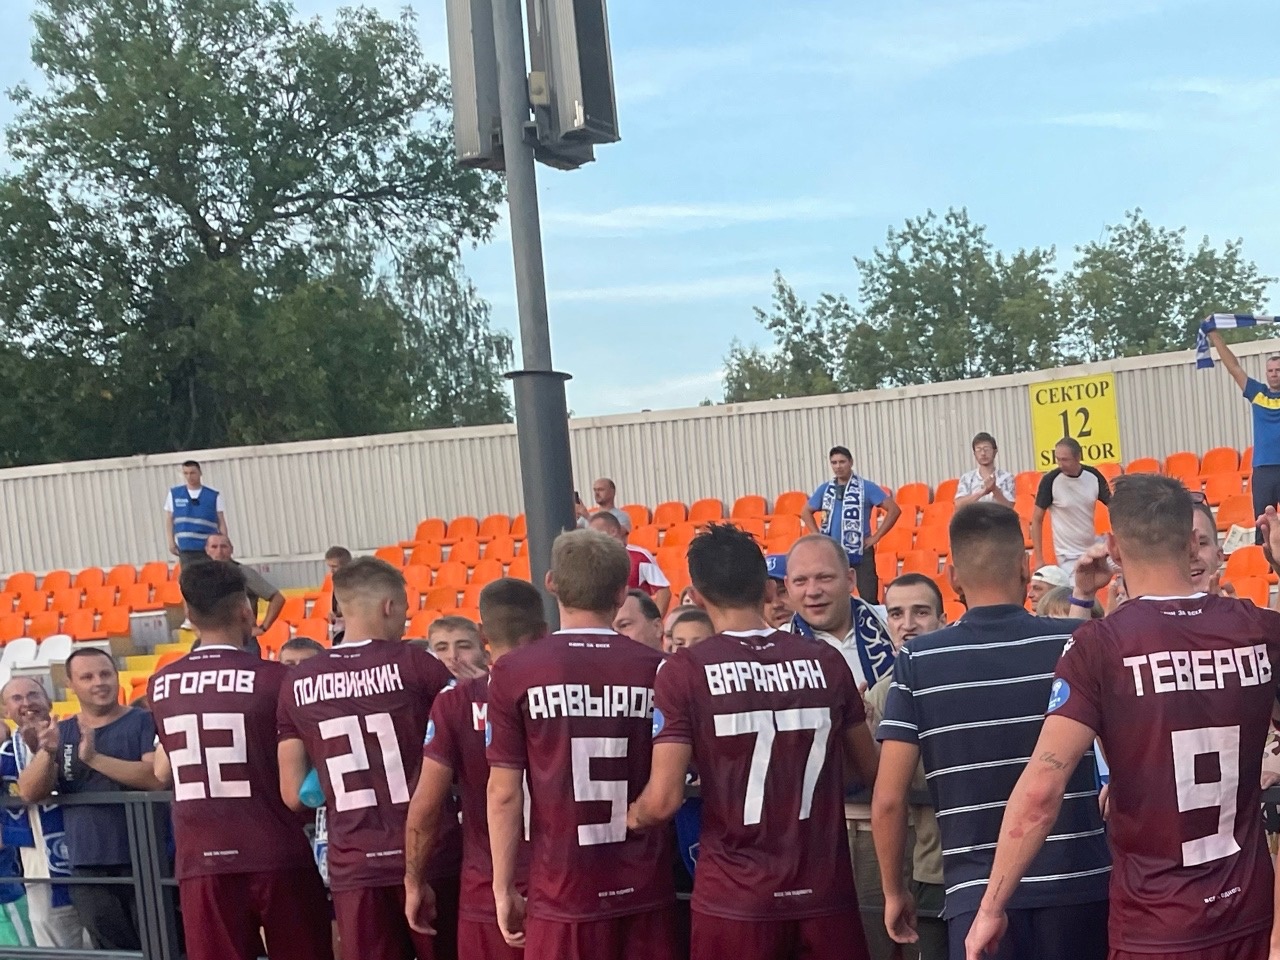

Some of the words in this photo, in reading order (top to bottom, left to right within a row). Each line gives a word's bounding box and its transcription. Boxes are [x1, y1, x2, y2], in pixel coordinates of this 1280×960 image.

[1036, 380, 1110, 406] СЕКТОР
[1059, 407, 1093, 439] 12
[1041, 443, 1115, 466] STOR
[153, 669, 256, 702] ЕГОРОВ
[293, 663, 404, 707] ПОЛОВИНКИН
[1123, 643, 1272, 696] ТЕВЕРОВ
[163, 712, 251, 801] 22
[318, 712, 410, 812] 21
[713, 707, 831, 826] 77
[571, 737, 628, 846] 5
[1171, 725, 1241, 867] 9
